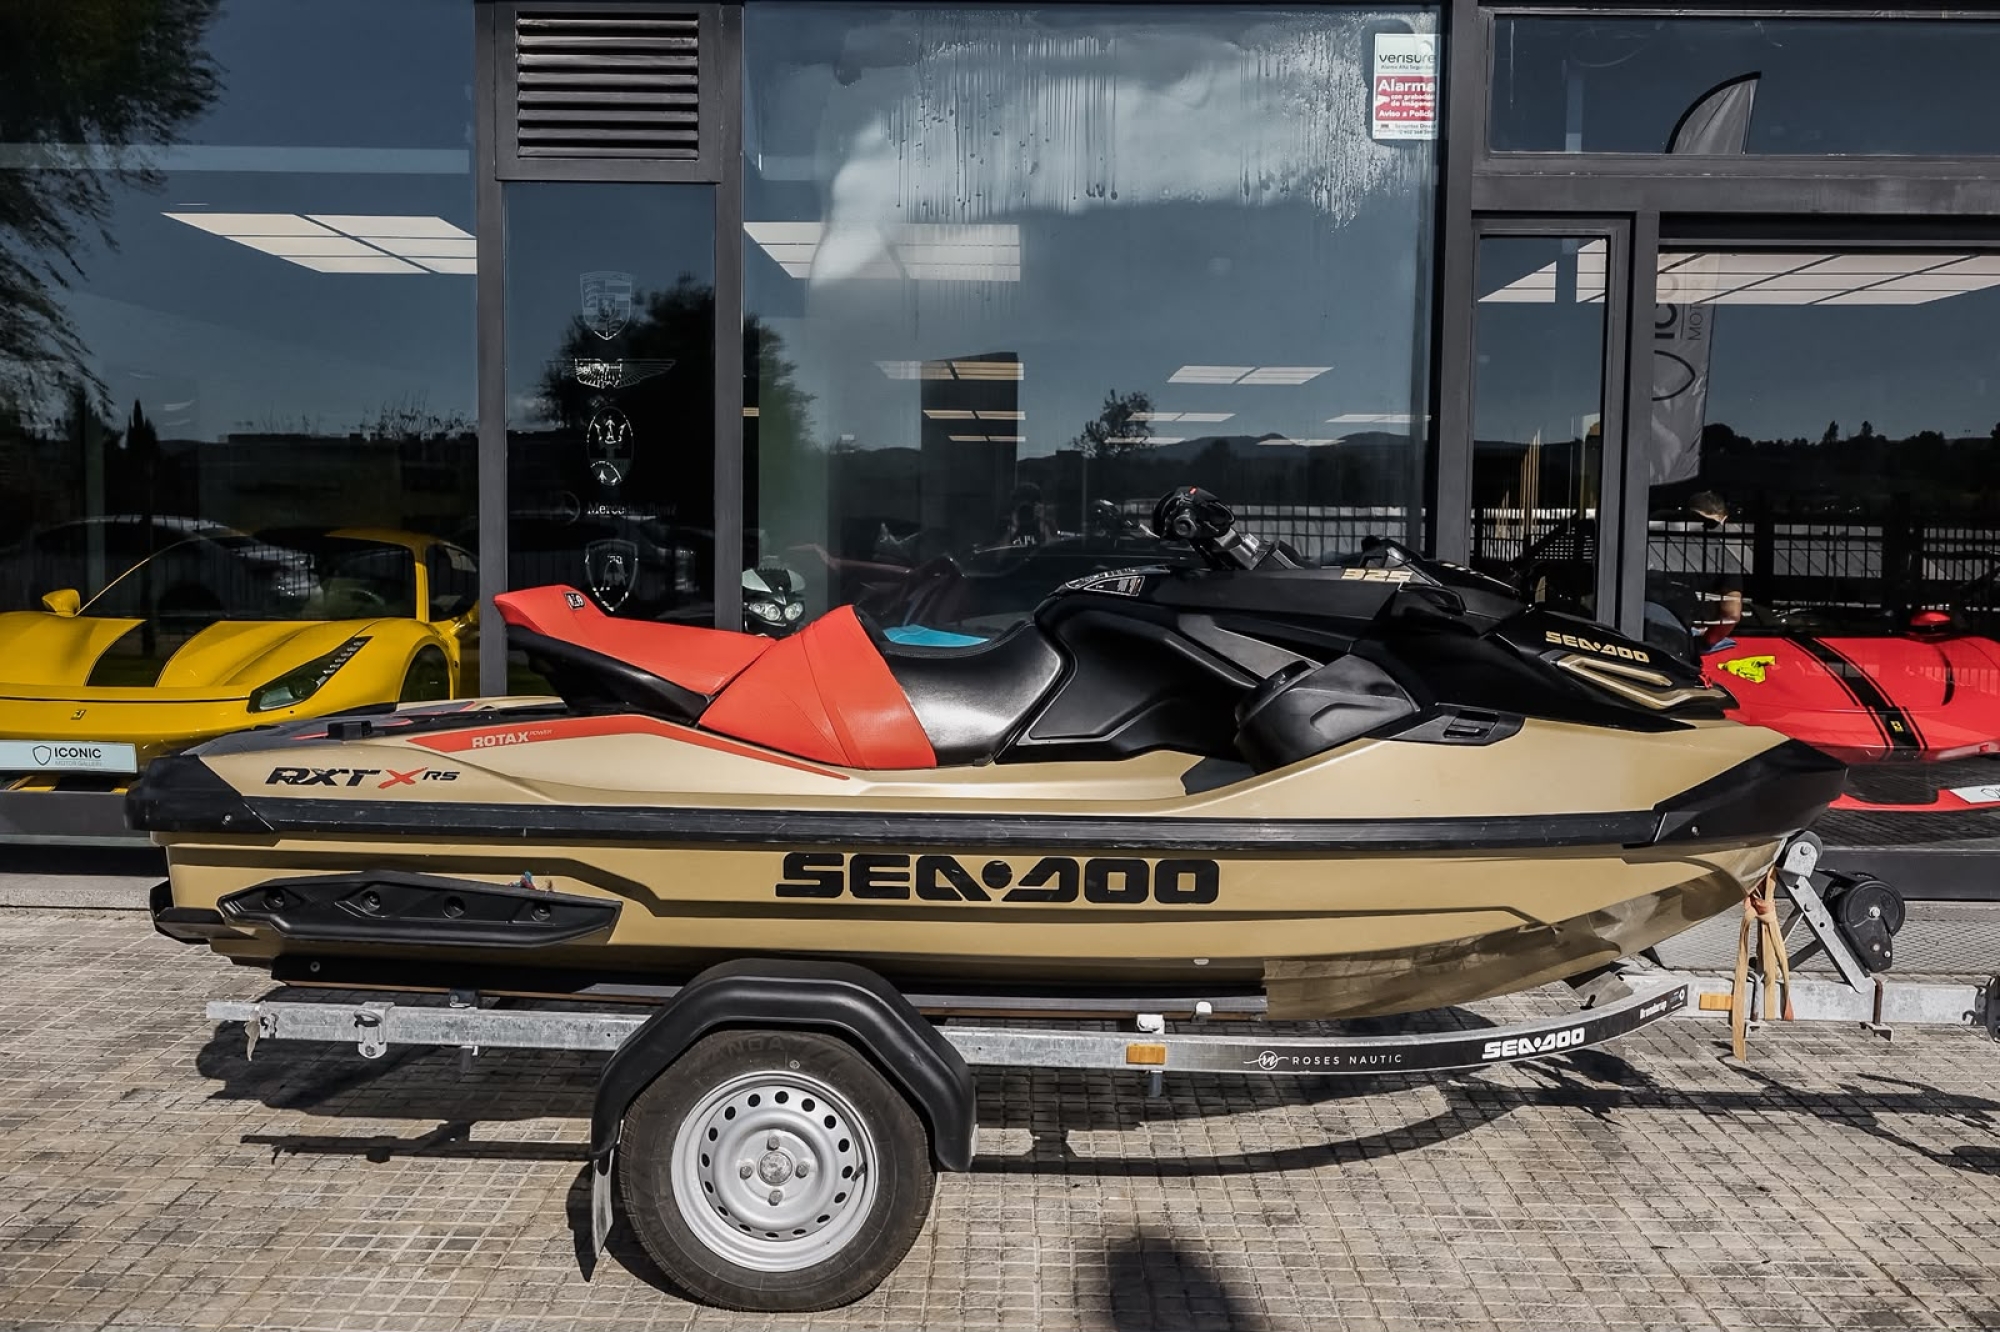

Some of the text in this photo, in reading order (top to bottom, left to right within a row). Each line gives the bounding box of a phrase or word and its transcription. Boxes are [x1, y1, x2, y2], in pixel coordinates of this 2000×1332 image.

[1379, 54, 1435, 63] verisure
[1378, 78, 1435, 92] Alarma
[1378, 109, 1400, 117] Aviso
[472, 731, 529, 748] ROTAX
[54, 747, 102, 759] ICONIC
[1292, 1054, 1403, 1066] ROSES NAUTIC
